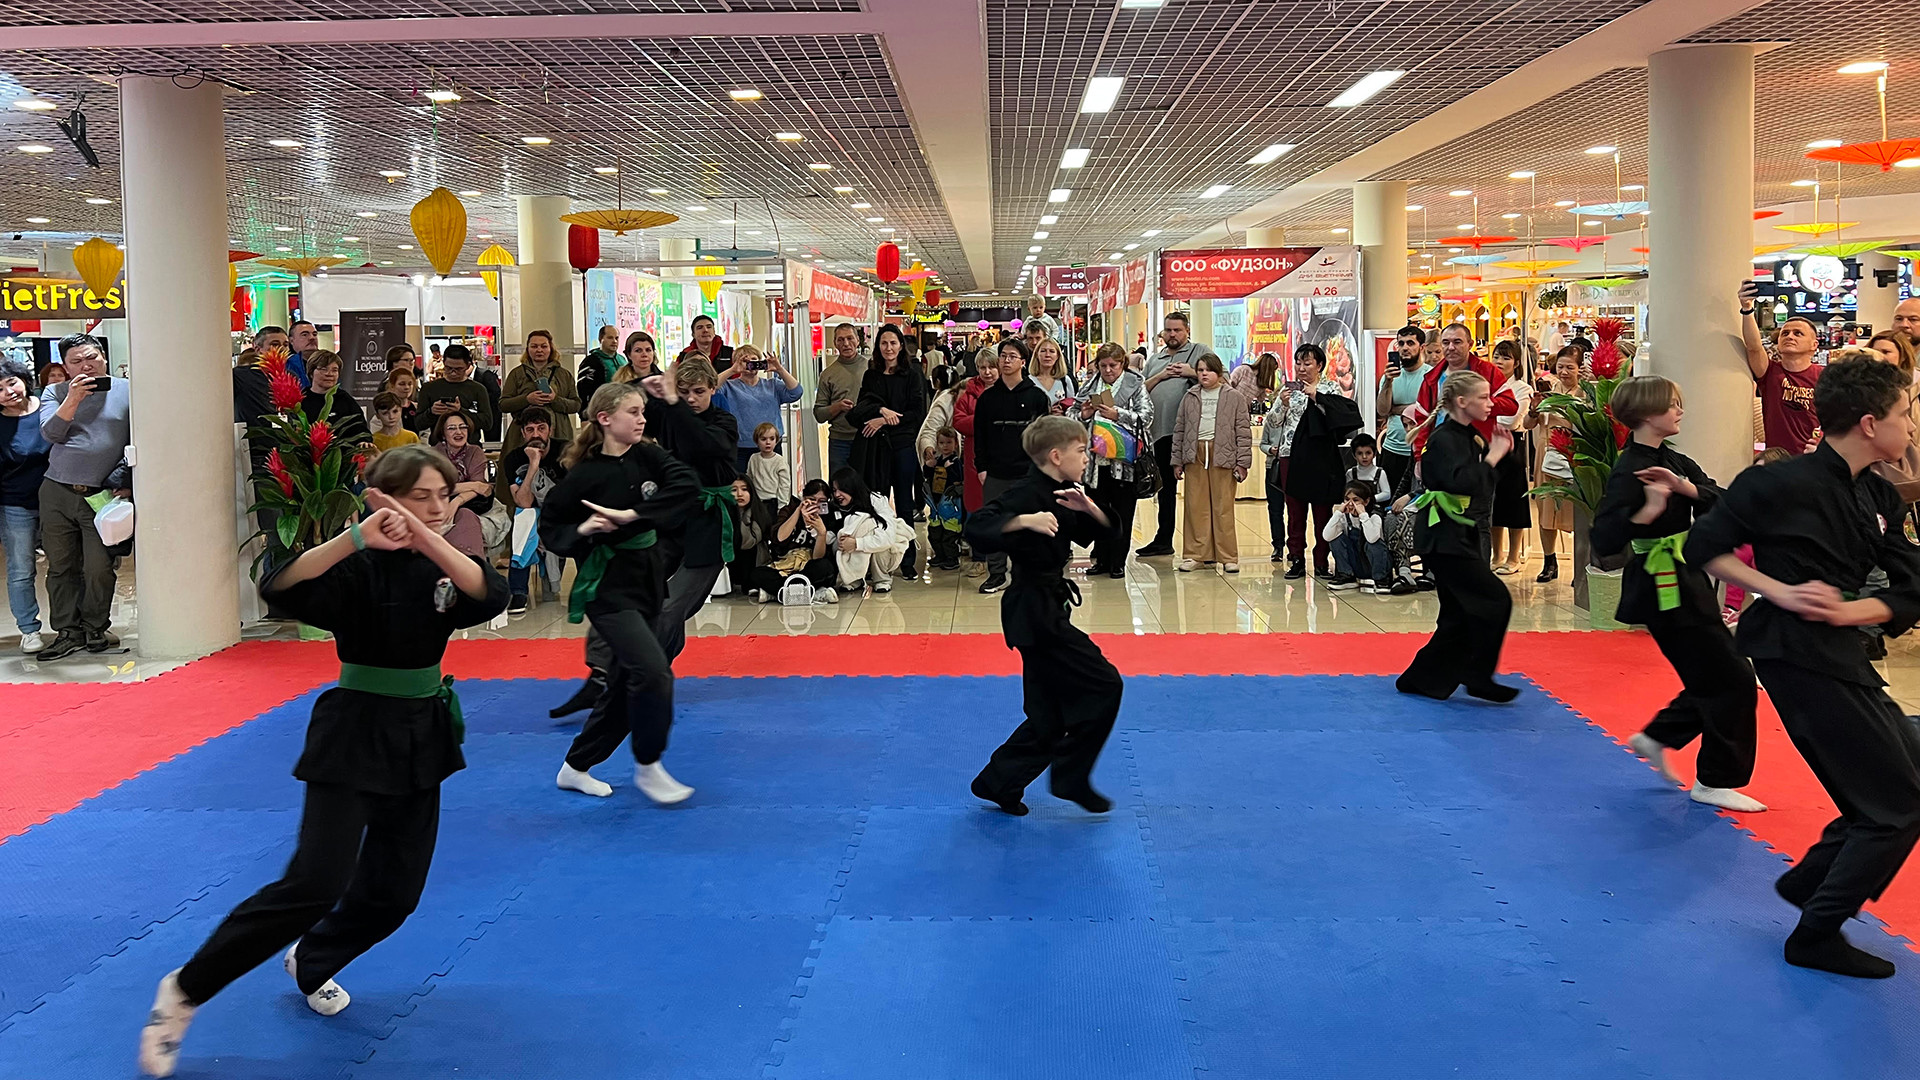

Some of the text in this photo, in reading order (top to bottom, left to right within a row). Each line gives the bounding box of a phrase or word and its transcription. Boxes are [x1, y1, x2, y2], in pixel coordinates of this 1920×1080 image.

[1170, 257, 1294, 274] ООО «ФУДЗОН»
[0, 280, 126, 311] ietFres
[1324, 286, 1338, 296] 26
[355, 360, 387, 374] Legend
